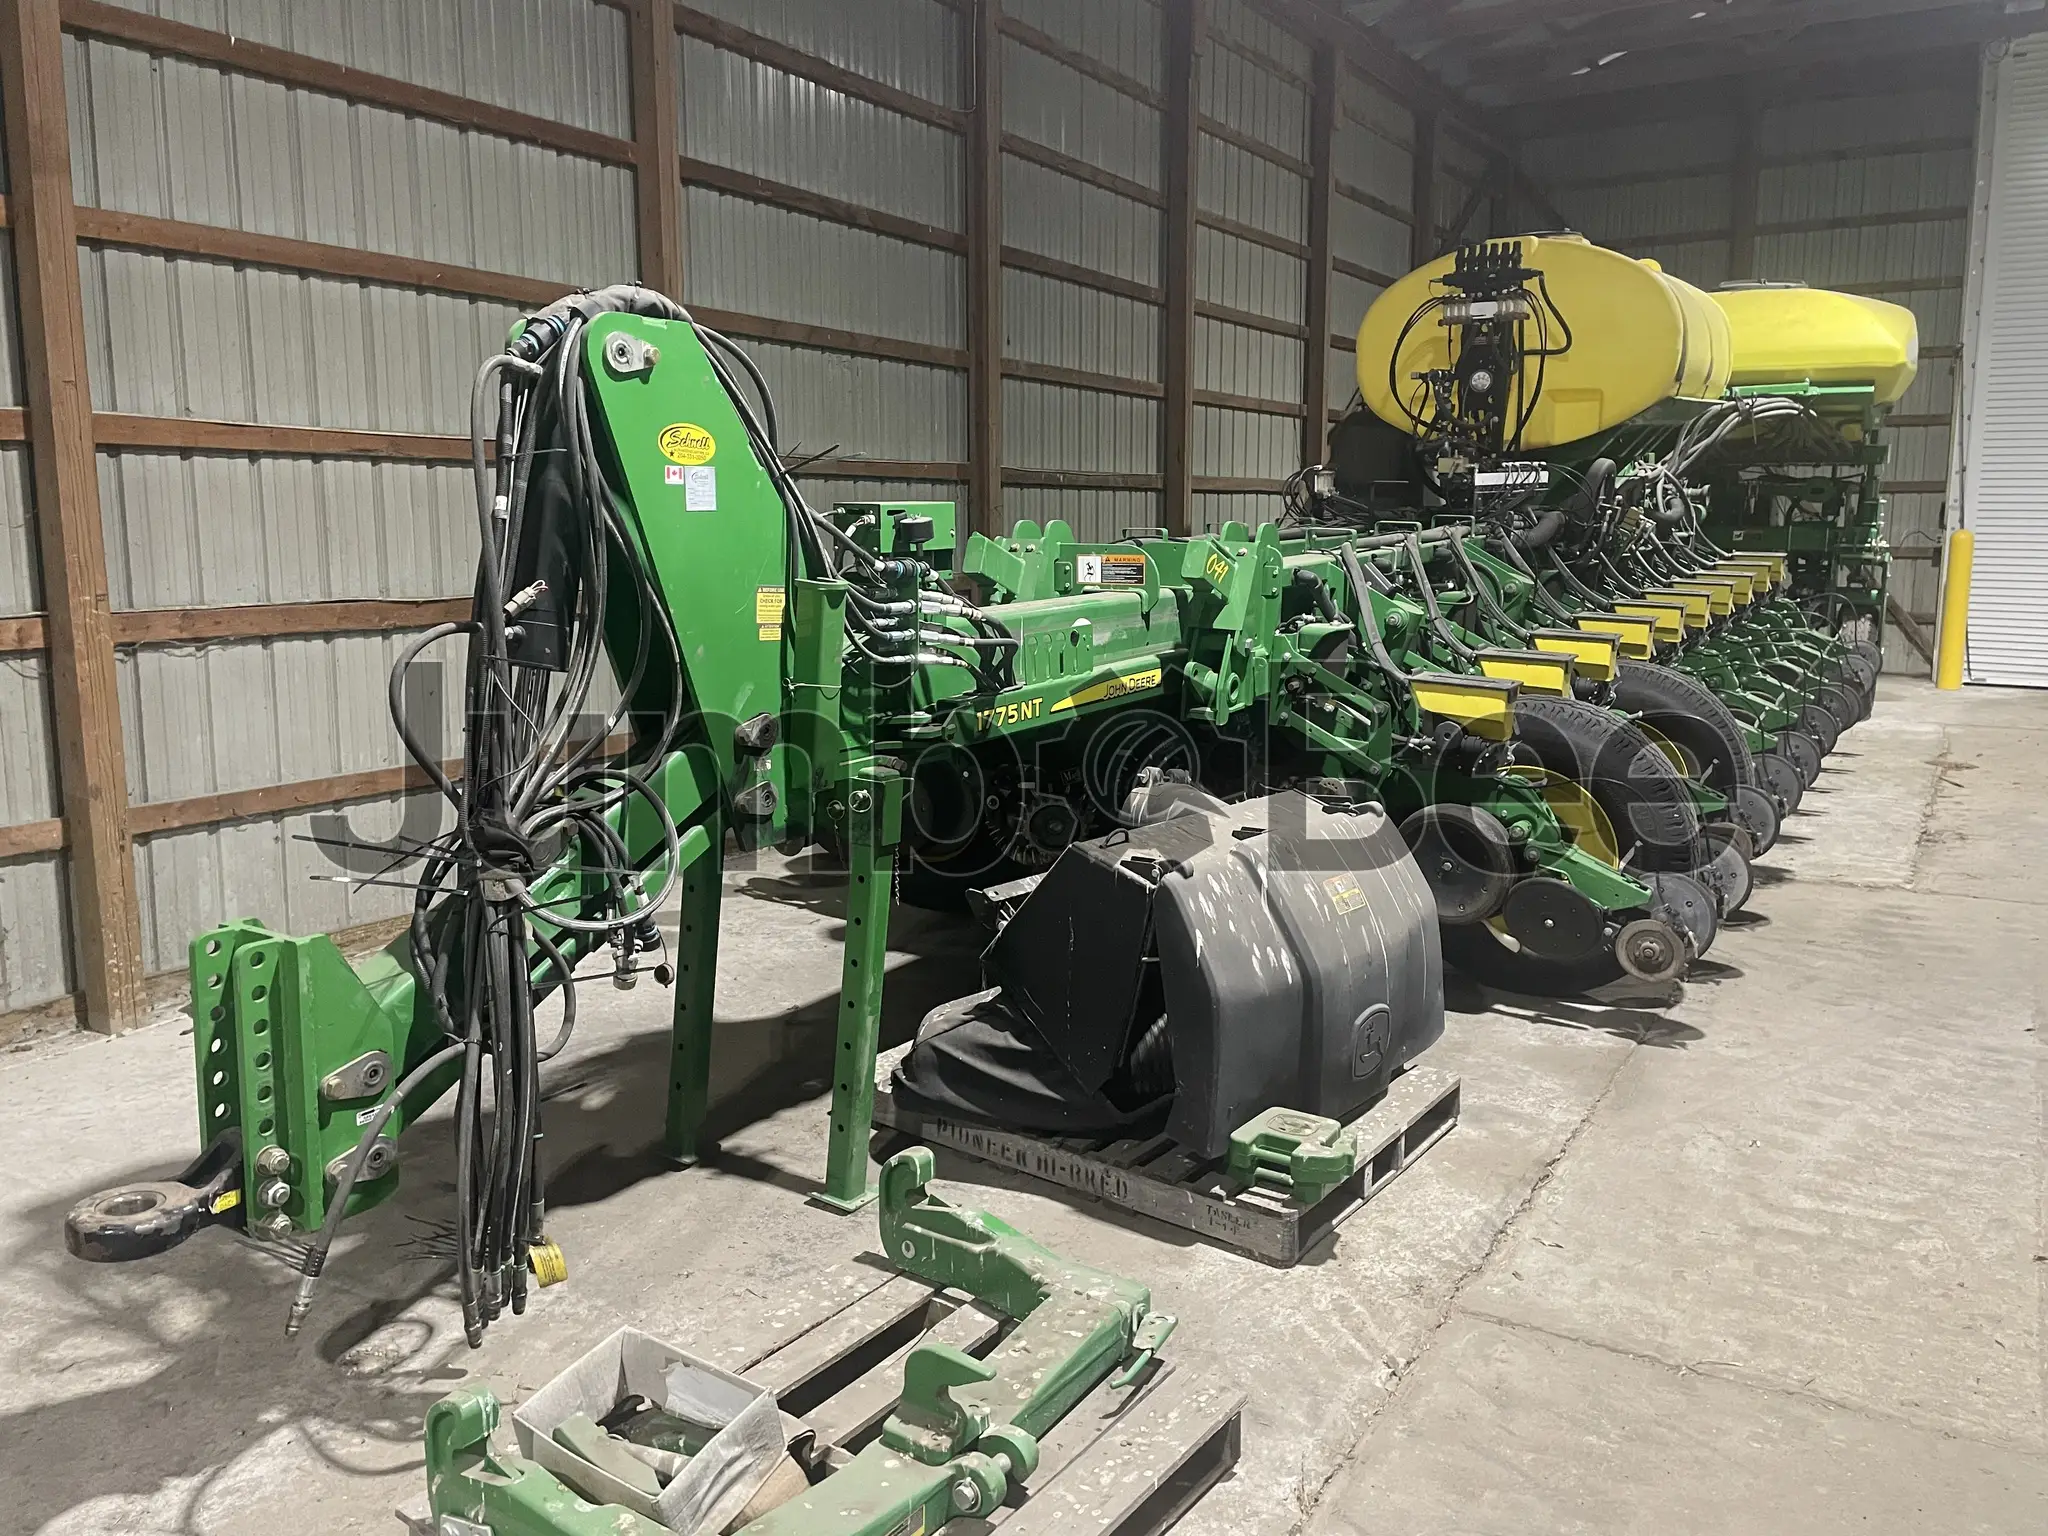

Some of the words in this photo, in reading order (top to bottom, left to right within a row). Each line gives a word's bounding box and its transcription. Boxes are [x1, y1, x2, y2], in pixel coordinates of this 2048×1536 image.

[666, 430, 711, 450] Schnell
[1102, 681, 1128, 700] JOHN
[1127, 674, 1157, 694] DEERE
[936, 1116, 1028, 1168] PIONEER
[1036, 1155, 1129, 1200] HI-BRED
